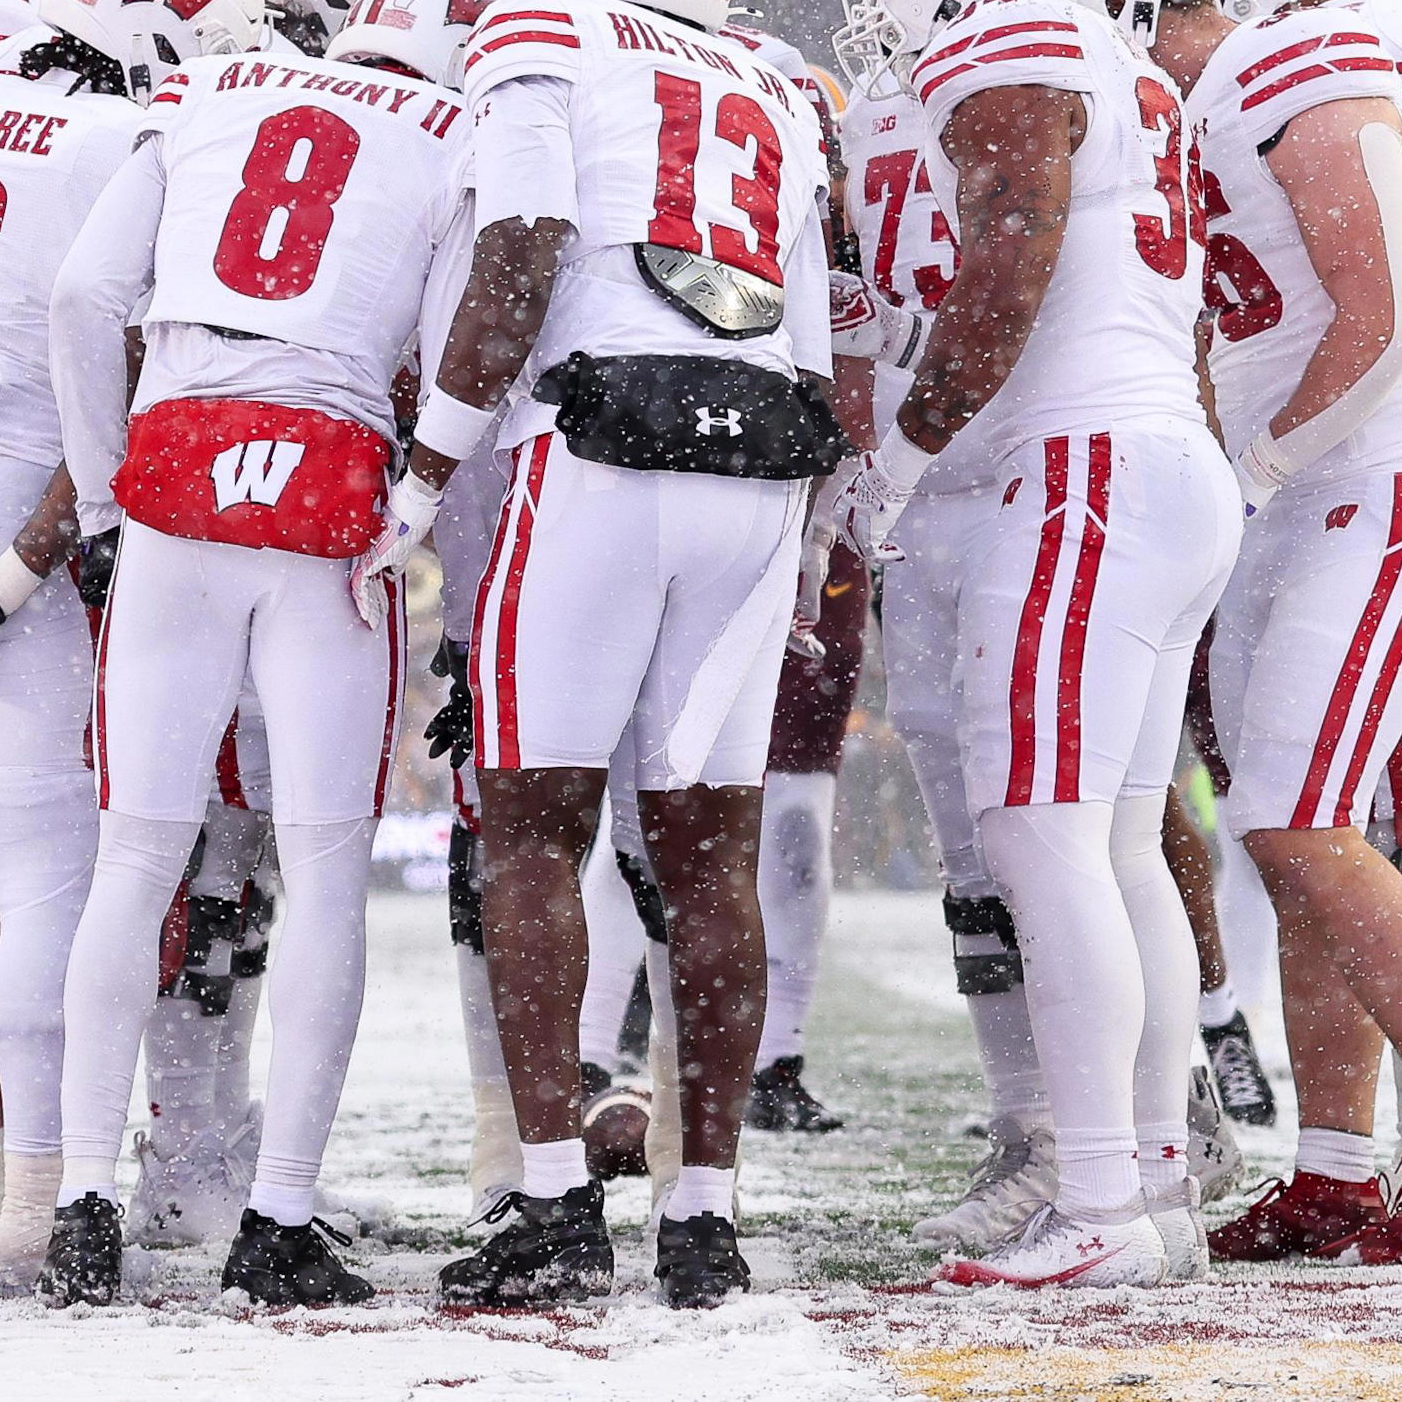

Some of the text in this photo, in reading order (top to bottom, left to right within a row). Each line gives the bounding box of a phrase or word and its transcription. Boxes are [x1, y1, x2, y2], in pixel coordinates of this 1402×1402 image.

[606, 12, 744, 81] HILTON
[216, 61, 464, 140] ANTHONY II
[213, 105, 361, 301] 8
[648, 70, 785, 288] 13
[864, 149, 962, 311] 73
[210, 440, 305, 507] W
[1325, 504, 1358, 532] W
